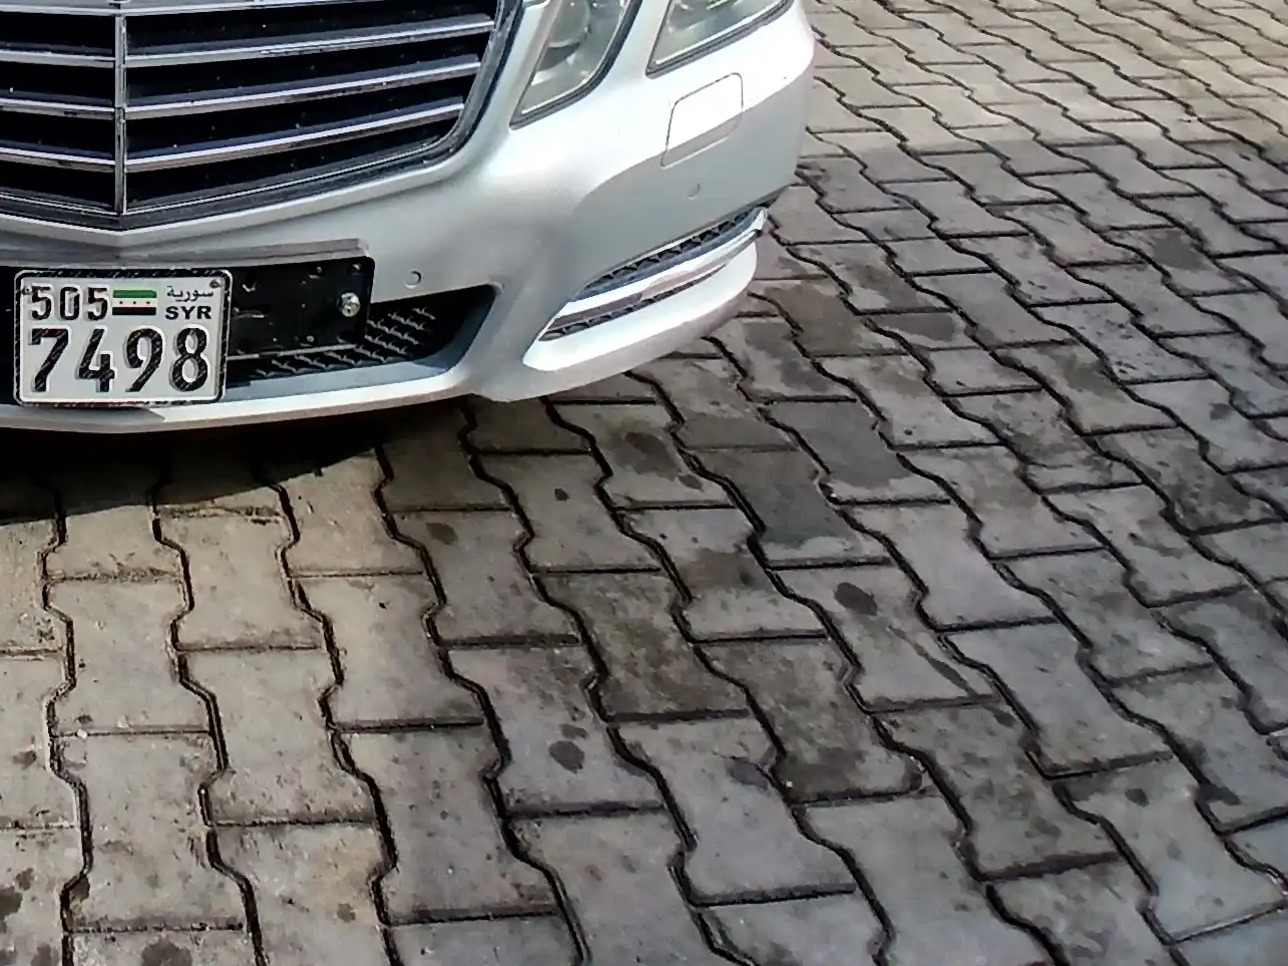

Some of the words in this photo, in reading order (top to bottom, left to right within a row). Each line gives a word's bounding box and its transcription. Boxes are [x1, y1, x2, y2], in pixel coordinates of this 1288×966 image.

[31, 285, 109, 321] 505
[166, 285, 214, 302] سورية
[164, 305, 212, 320] SYR
[30, 328, 209, 392] 7498
